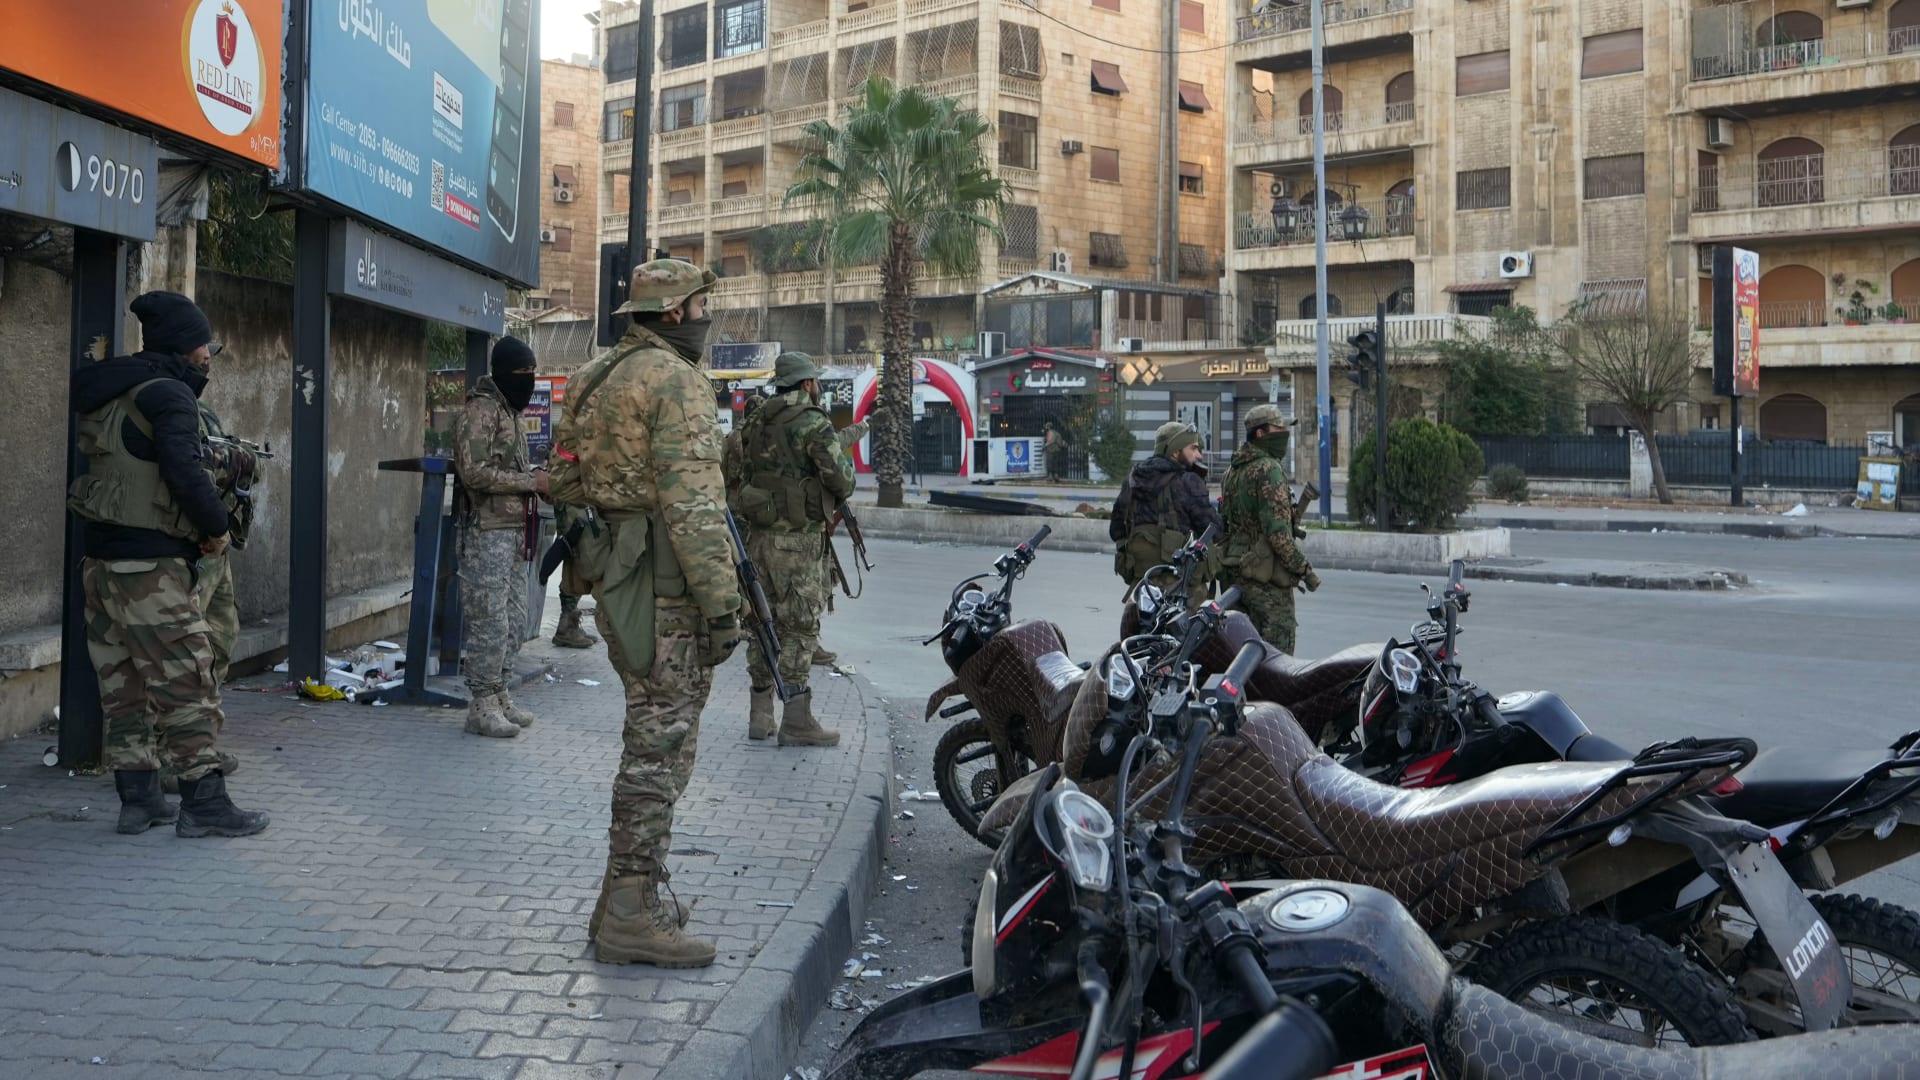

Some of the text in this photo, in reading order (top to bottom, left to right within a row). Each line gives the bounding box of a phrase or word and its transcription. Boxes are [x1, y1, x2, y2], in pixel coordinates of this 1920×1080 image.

[197, 58, 253, 104] RED LINE
[321, 102, 334, 125] Call
[335, 111, 357, 137] Center
[358, 121, 376, 151] 2053
[87, 153, 144, 204] 9070
[330, 139, 377, 185] www.siib.sy
[450, 199, 472, 222] DOWNLOAD
[1024, 368, 1087, 394] صيدلية
